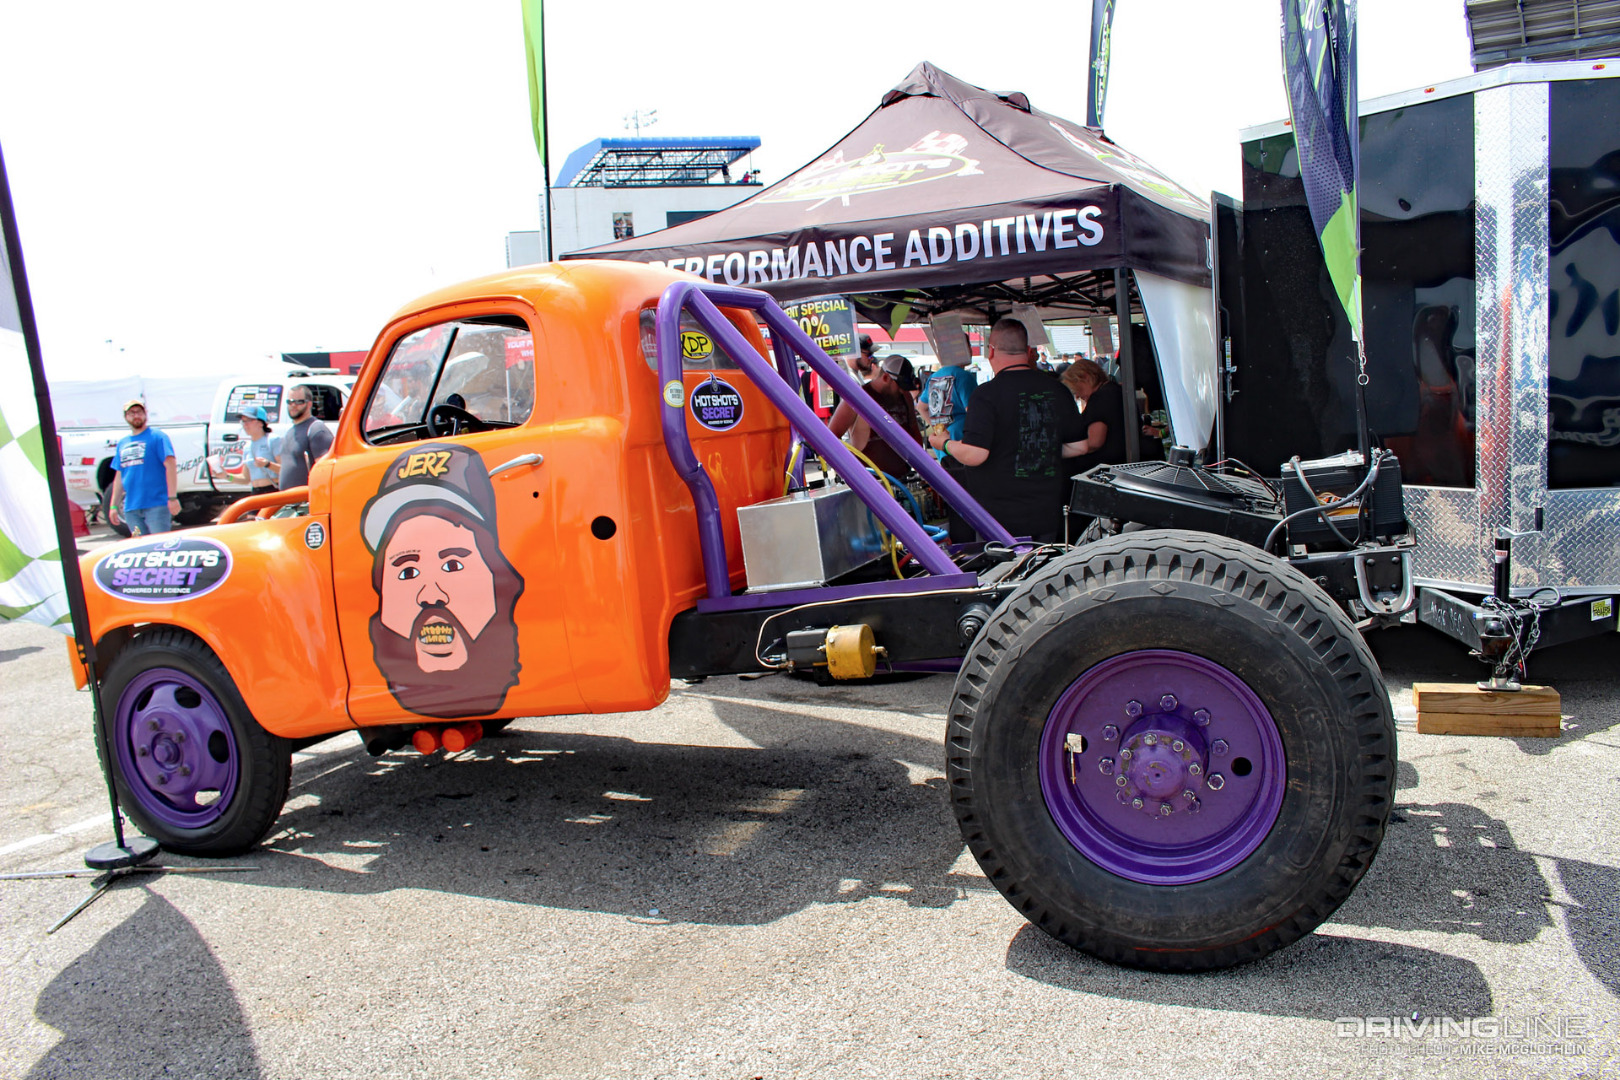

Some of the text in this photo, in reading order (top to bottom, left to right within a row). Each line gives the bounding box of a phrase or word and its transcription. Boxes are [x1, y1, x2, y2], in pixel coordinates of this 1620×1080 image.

[648, 205, 1104, 287] RFORMANCE ADDITIVES
[800, 299, 849, 316] SPECIAL
[792, 314, 830, 337] 0%
[814, 333, 851, 348] ITEMS!
[702, 406, 735, 420] SECRET
[398, 451, 451, 479] JERZ
[308, 532, 322, 543] 53
[112, 567, 203, 586] SECRET
